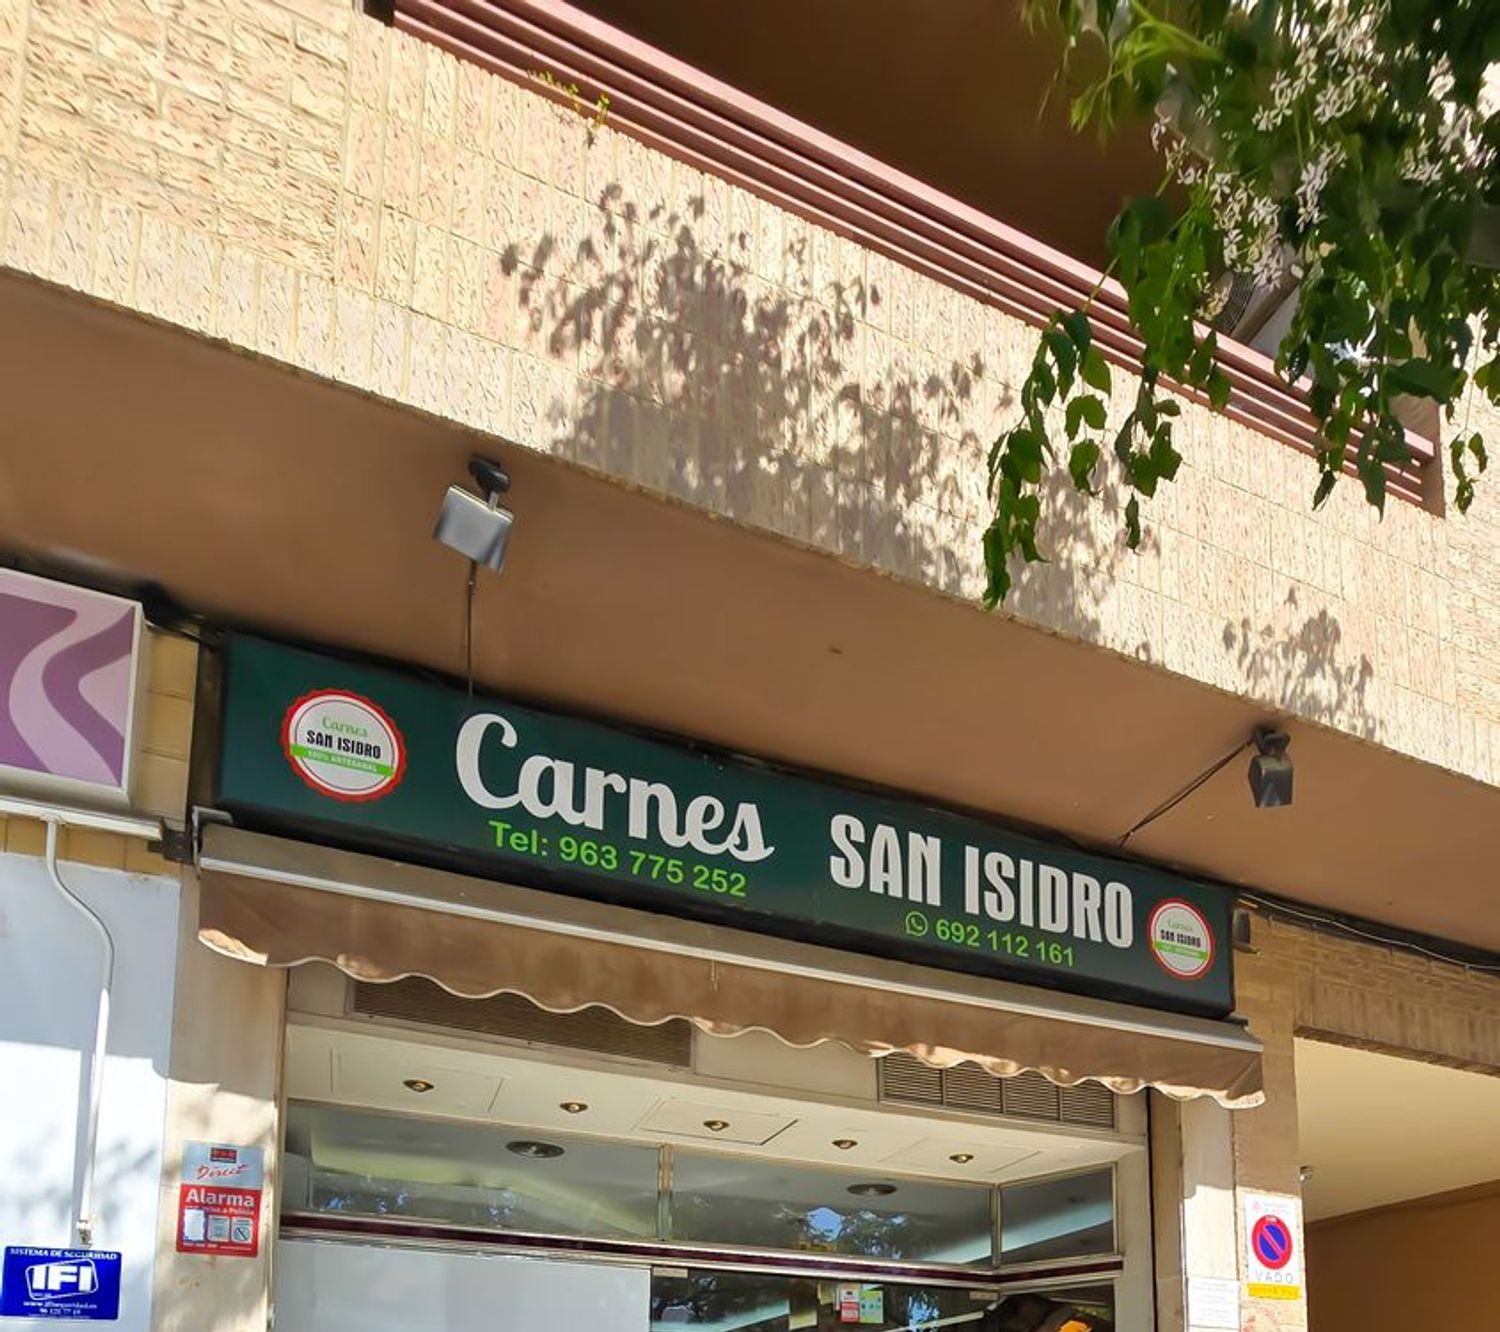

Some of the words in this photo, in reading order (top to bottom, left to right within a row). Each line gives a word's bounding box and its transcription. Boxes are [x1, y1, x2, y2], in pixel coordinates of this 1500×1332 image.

[322, 714, 368, 738] Carnes
[306, 730, 333, 748] SAN
[337, 737, 381, 760] ISIDRO
[455, 712, 775, 862] Carnes
[488, 820, 547, 858] Tel:
[559, 835, 619, 871] 963
[629, 851, 684, 884] 775
[693, 864, 747, 898] 252
[830, 813, 941, 907] SAN
[965, 846, 1134, 949] ISIDRO
[935, 919, 980, 947] 692
[987, 930, 1029, 958] 112
[1036, 940, 1074, 967] 161
[185, 1188, 256, 1208] Alarma
[10, 1248, 49, 1257] SISTEMA
[50, 1249, 62, 1258] DE
[64, 1250, 119, 1260] SEGURIDAD
[32, 1264, 92, 1292] IFI
[1255, 1270, 1294, 1285] VADO
